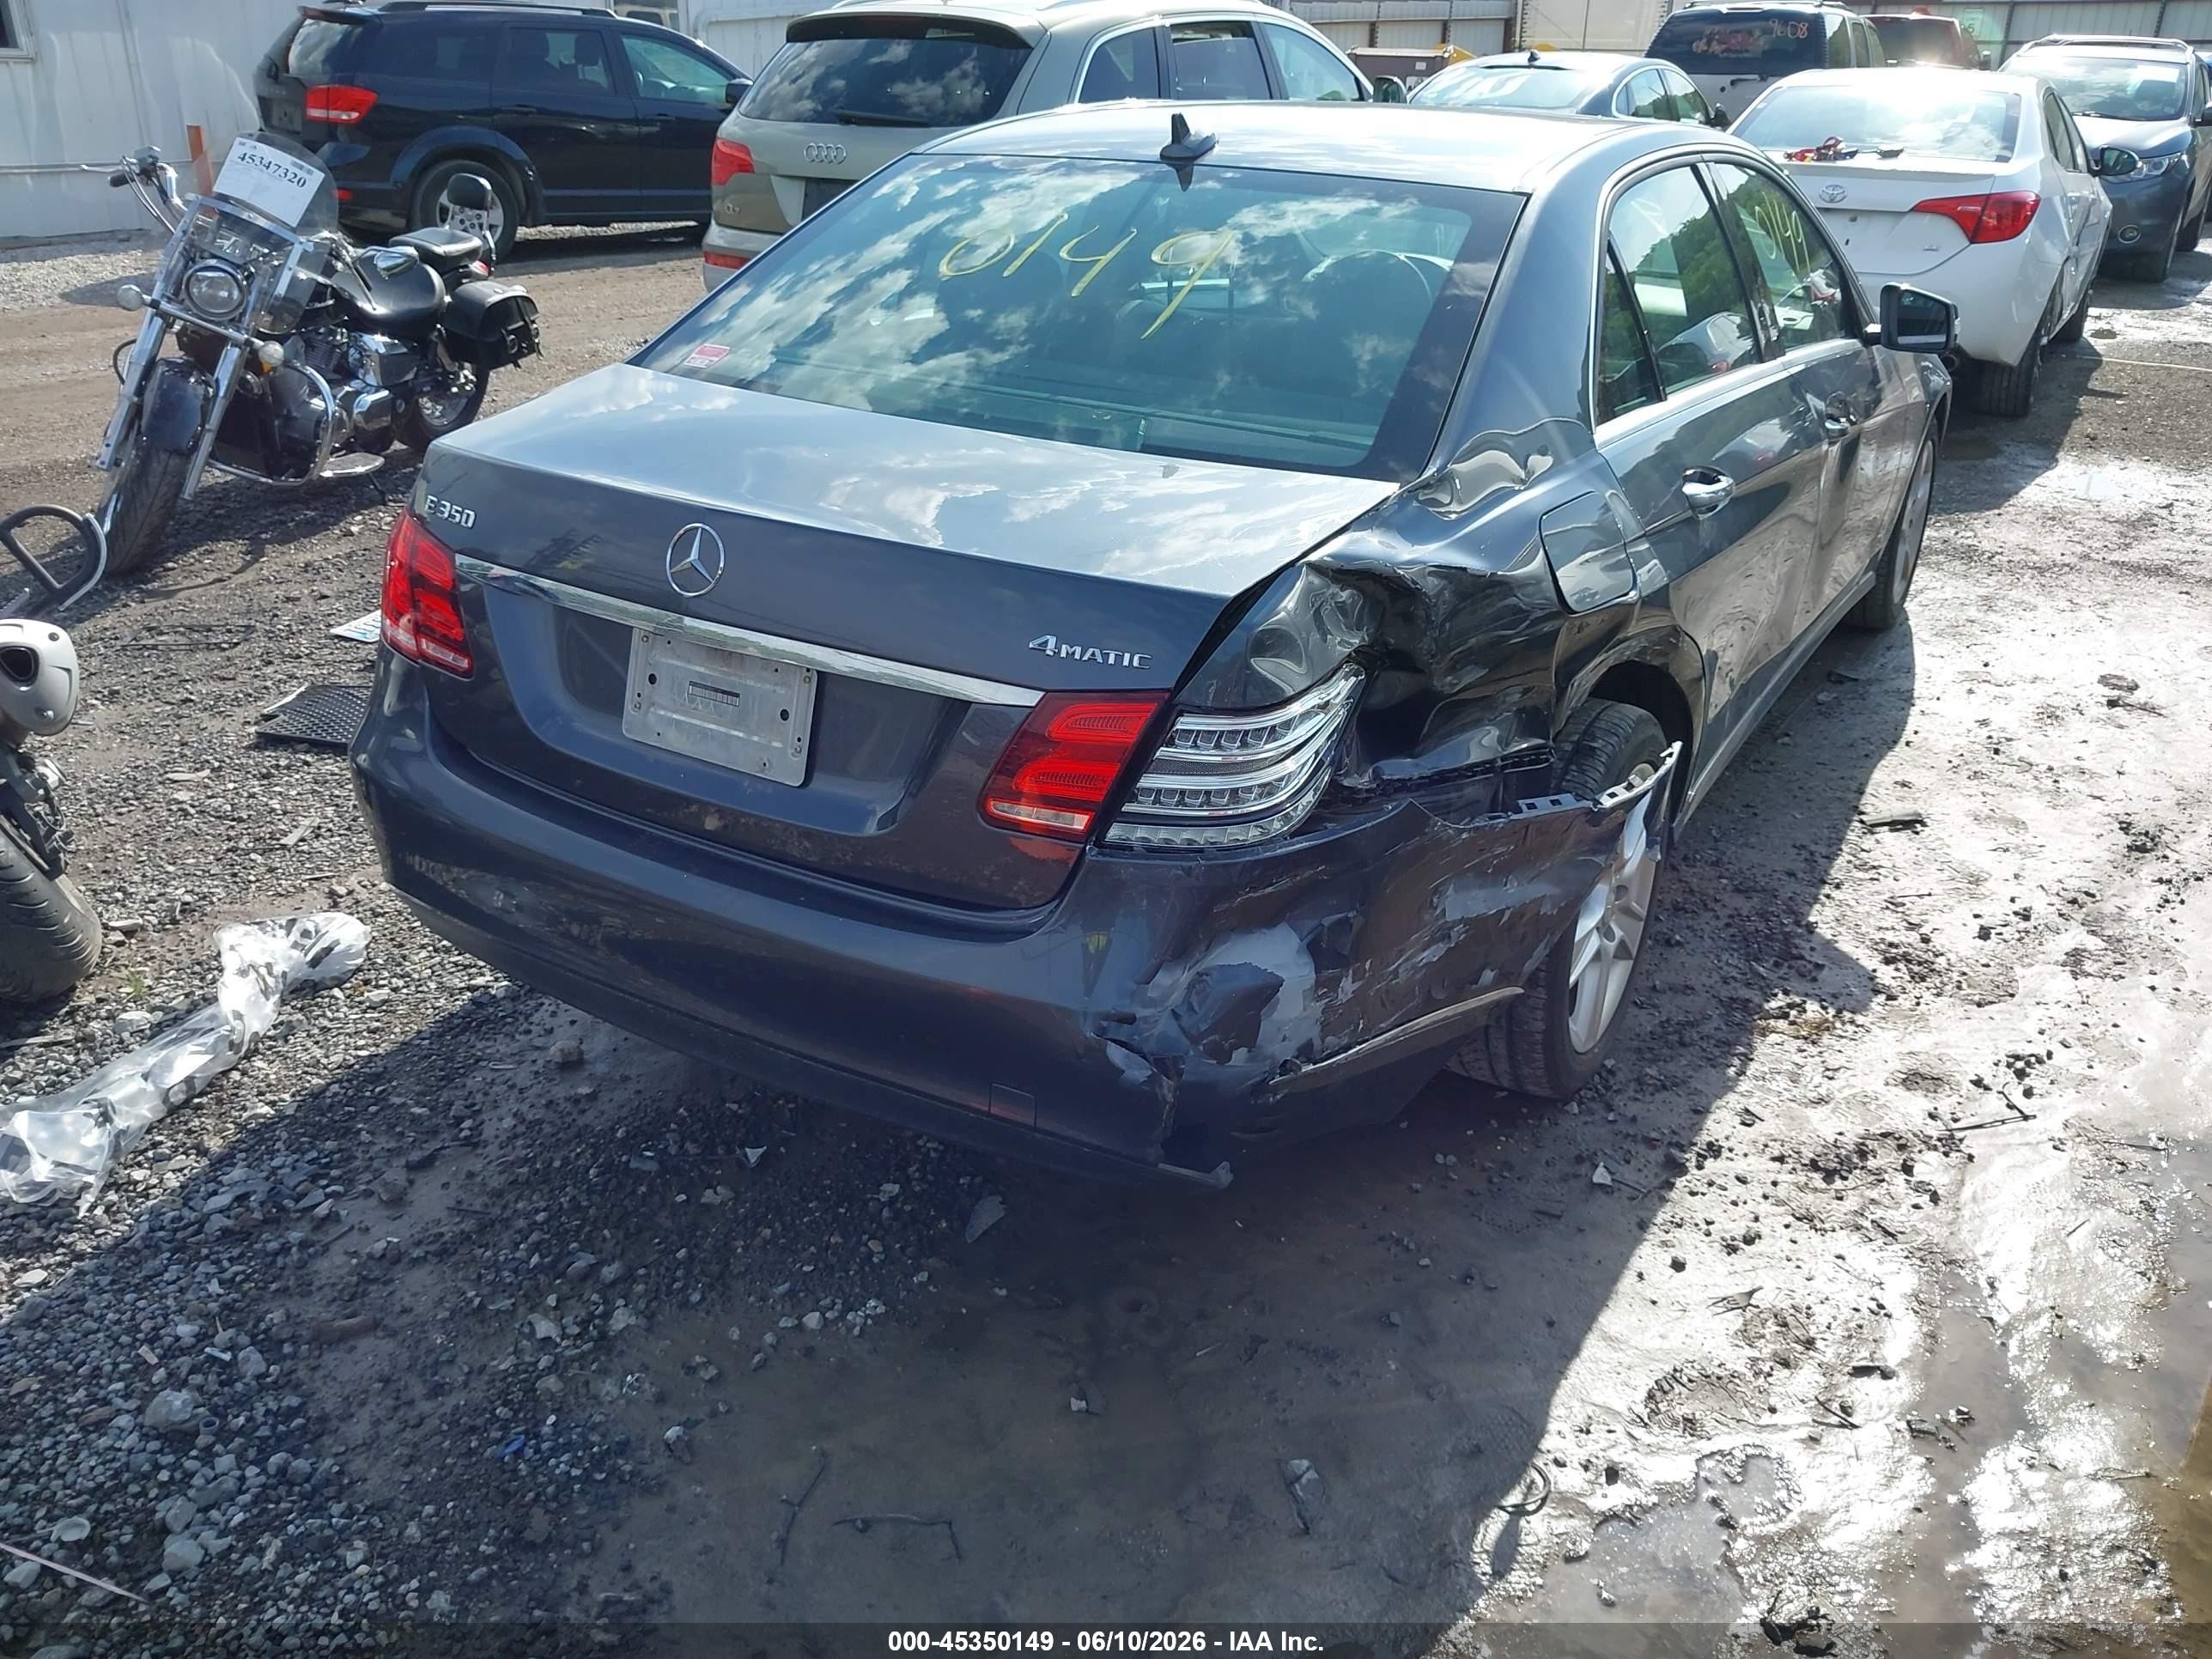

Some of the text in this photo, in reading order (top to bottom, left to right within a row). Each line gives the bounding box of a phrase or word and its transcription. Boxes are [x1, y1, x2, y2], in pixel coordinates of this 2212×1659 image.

[237, 152, 307, 188] 45347320
[1753, 191, 1811, 273] 0149
[939, 212, 1233, 339] 0149
[1029, 635, 1152, 669] 4MATIC
